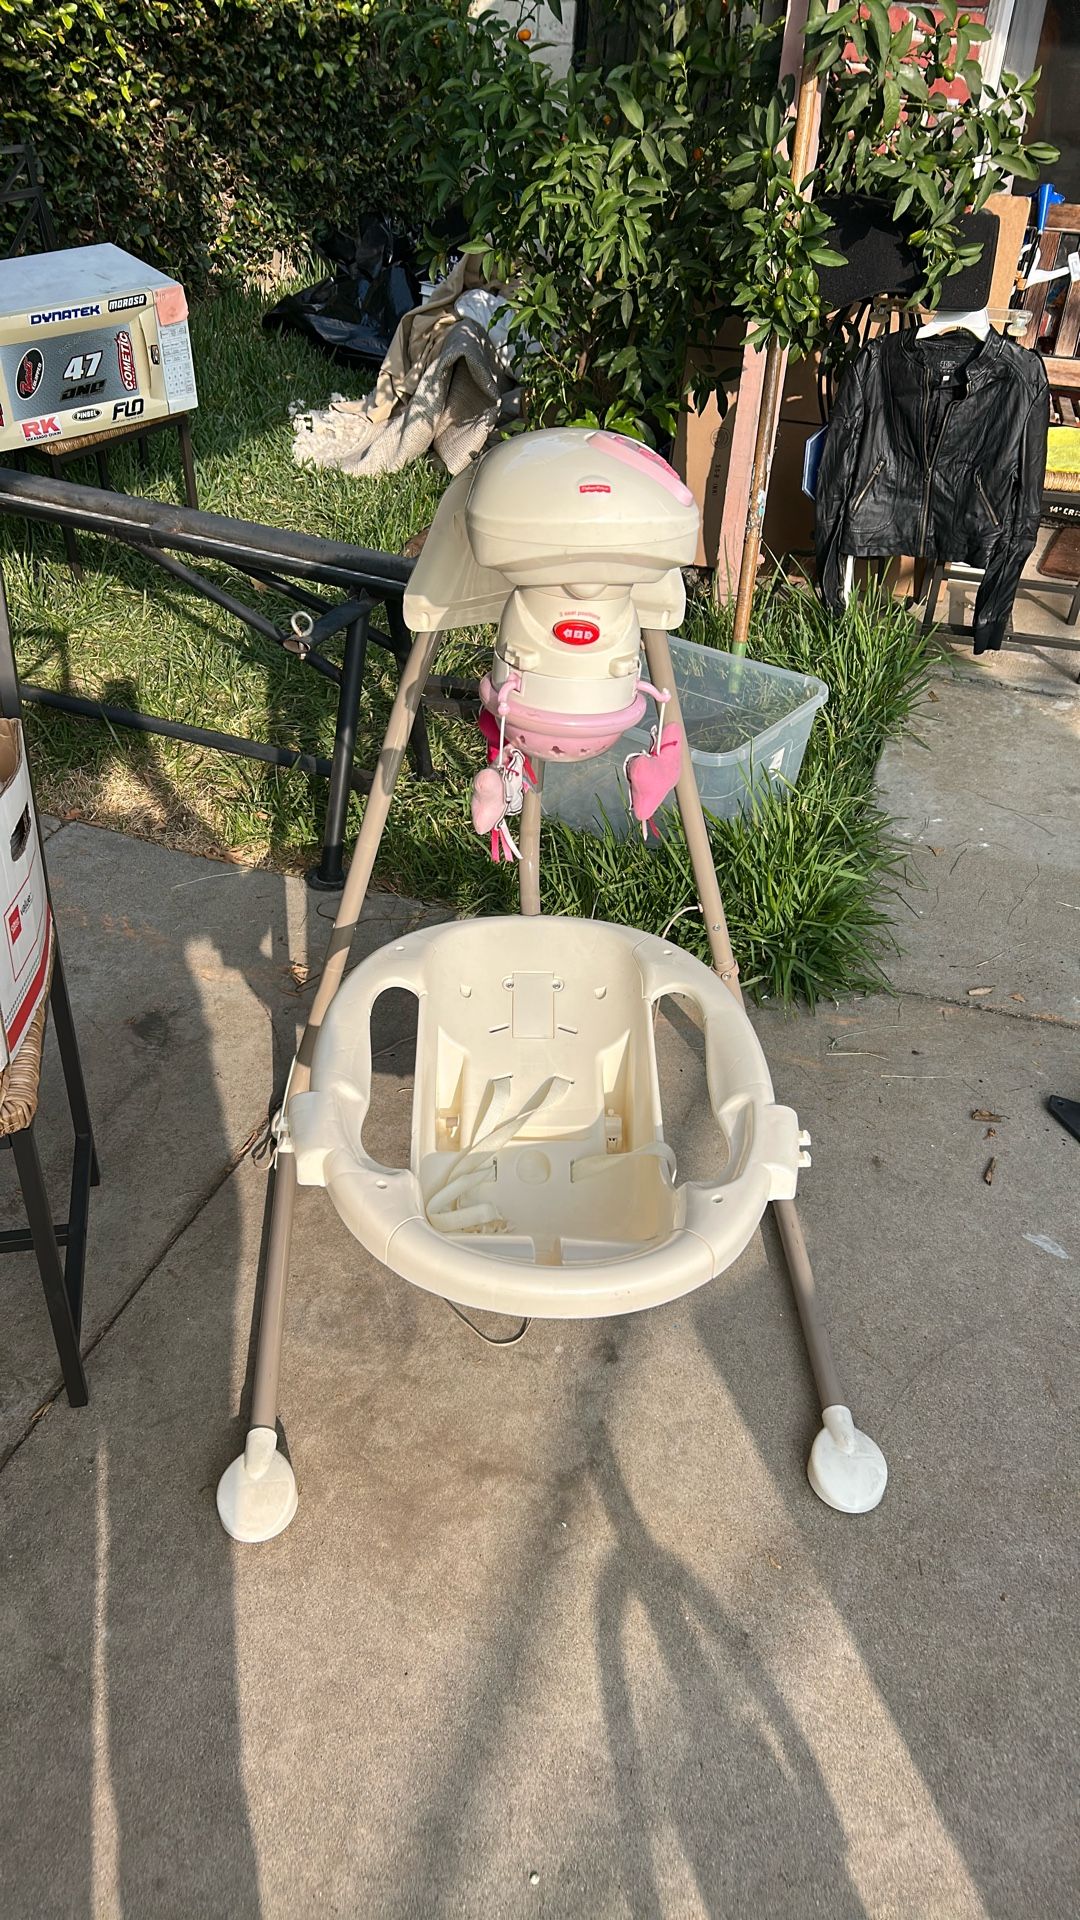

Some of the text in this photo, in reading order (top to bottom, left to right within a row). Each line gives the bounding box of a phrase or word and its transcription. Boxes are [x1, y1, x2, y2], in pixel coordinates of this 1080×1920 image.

[109, 295, 146, 310] MOROSO
[30, 304, 101, 325] DYNATEK
[63, 350, 103, 381] 47
[119, 332, 134, 390] COMETIC
[112, 398, 144, 421] FLO
[21, 416, 61, 438] RK
